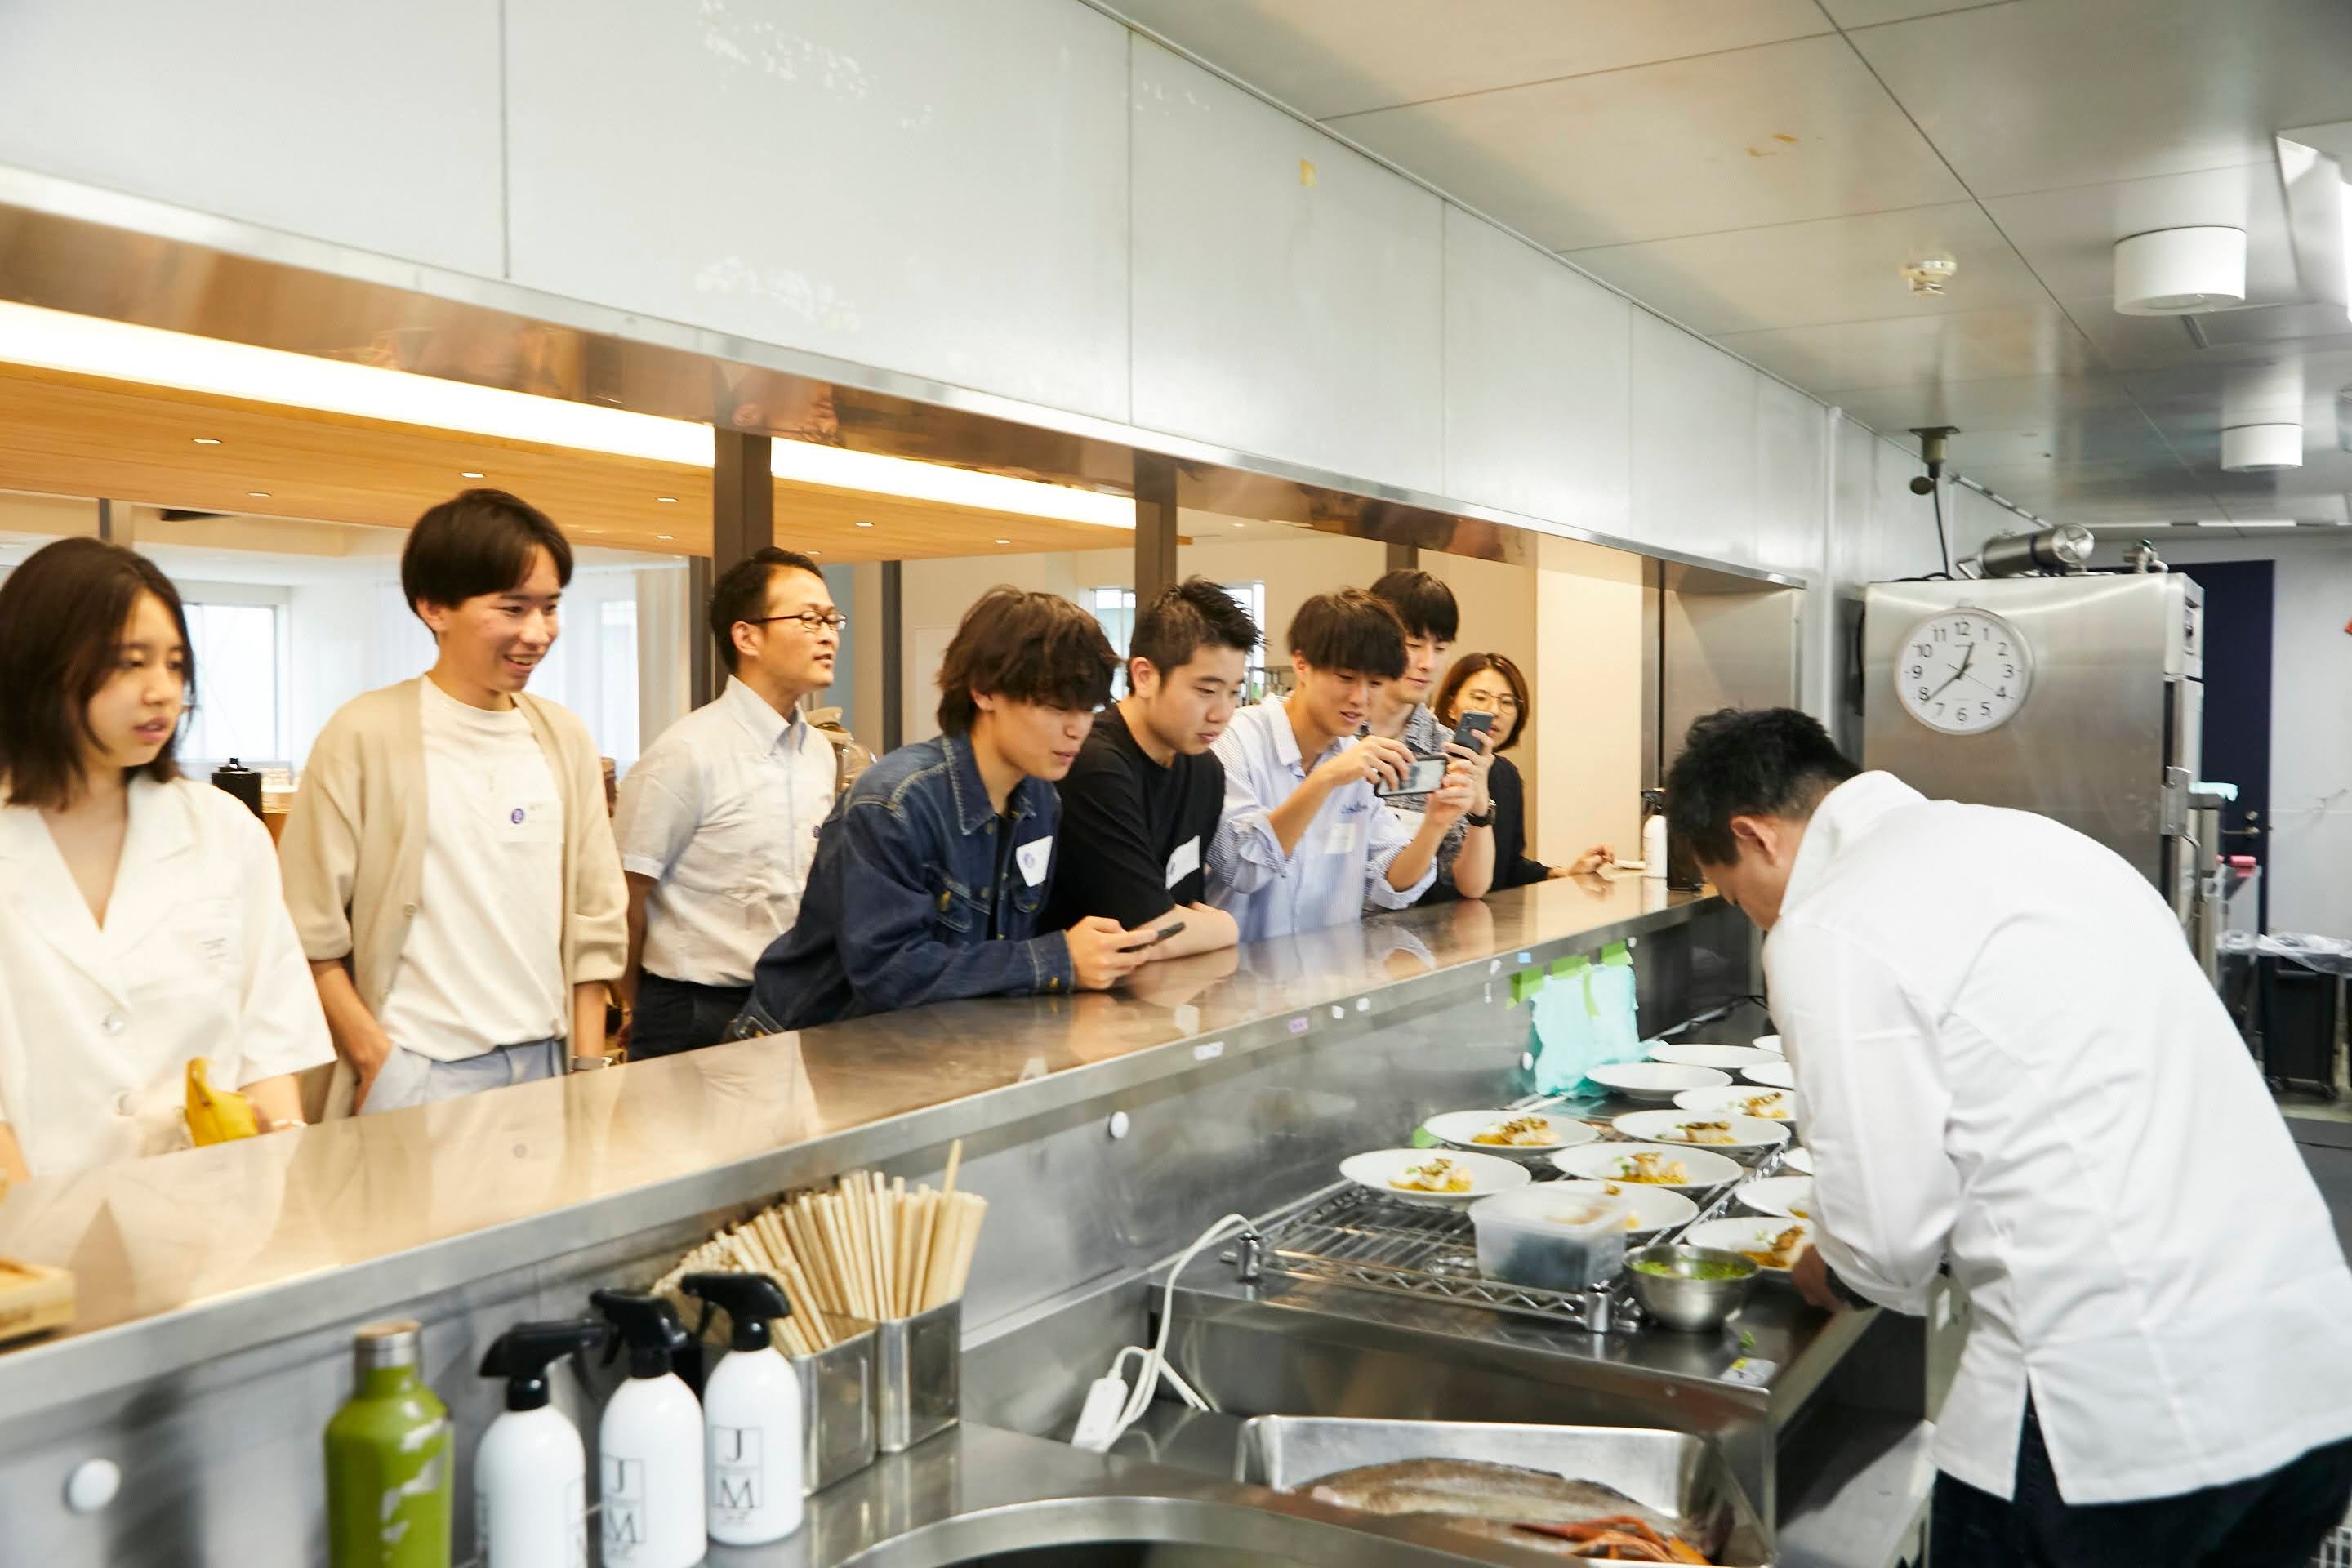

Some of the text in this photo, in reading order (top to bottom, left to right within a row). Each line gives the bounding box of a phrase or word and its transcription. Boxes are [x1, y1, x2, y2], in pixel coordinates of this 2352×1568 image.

[1933, 628, 1947, 642] 11
[1954, 621, 1971, 635] 12
[1983, 627, 1989, 641] 1
[1916, 644, 1932, 657] 10
[1998, 642, 2007, 656] 2
[1912, 665, 1922, 679] 9
[2003, 664, 2013, 678] 3
[1919, 687, 1929, 701] 8
[1936, 702, 1945, 716] 7
[1957, 708, 1967, 721] 6
[1980, 702, 1991, 715] 5
[725, 1429, 742, 1462] J
[612, 1459, 624, 1493] J
[718, 1478, 754, 1508] M
[605, 1509, 637, 1543] M
